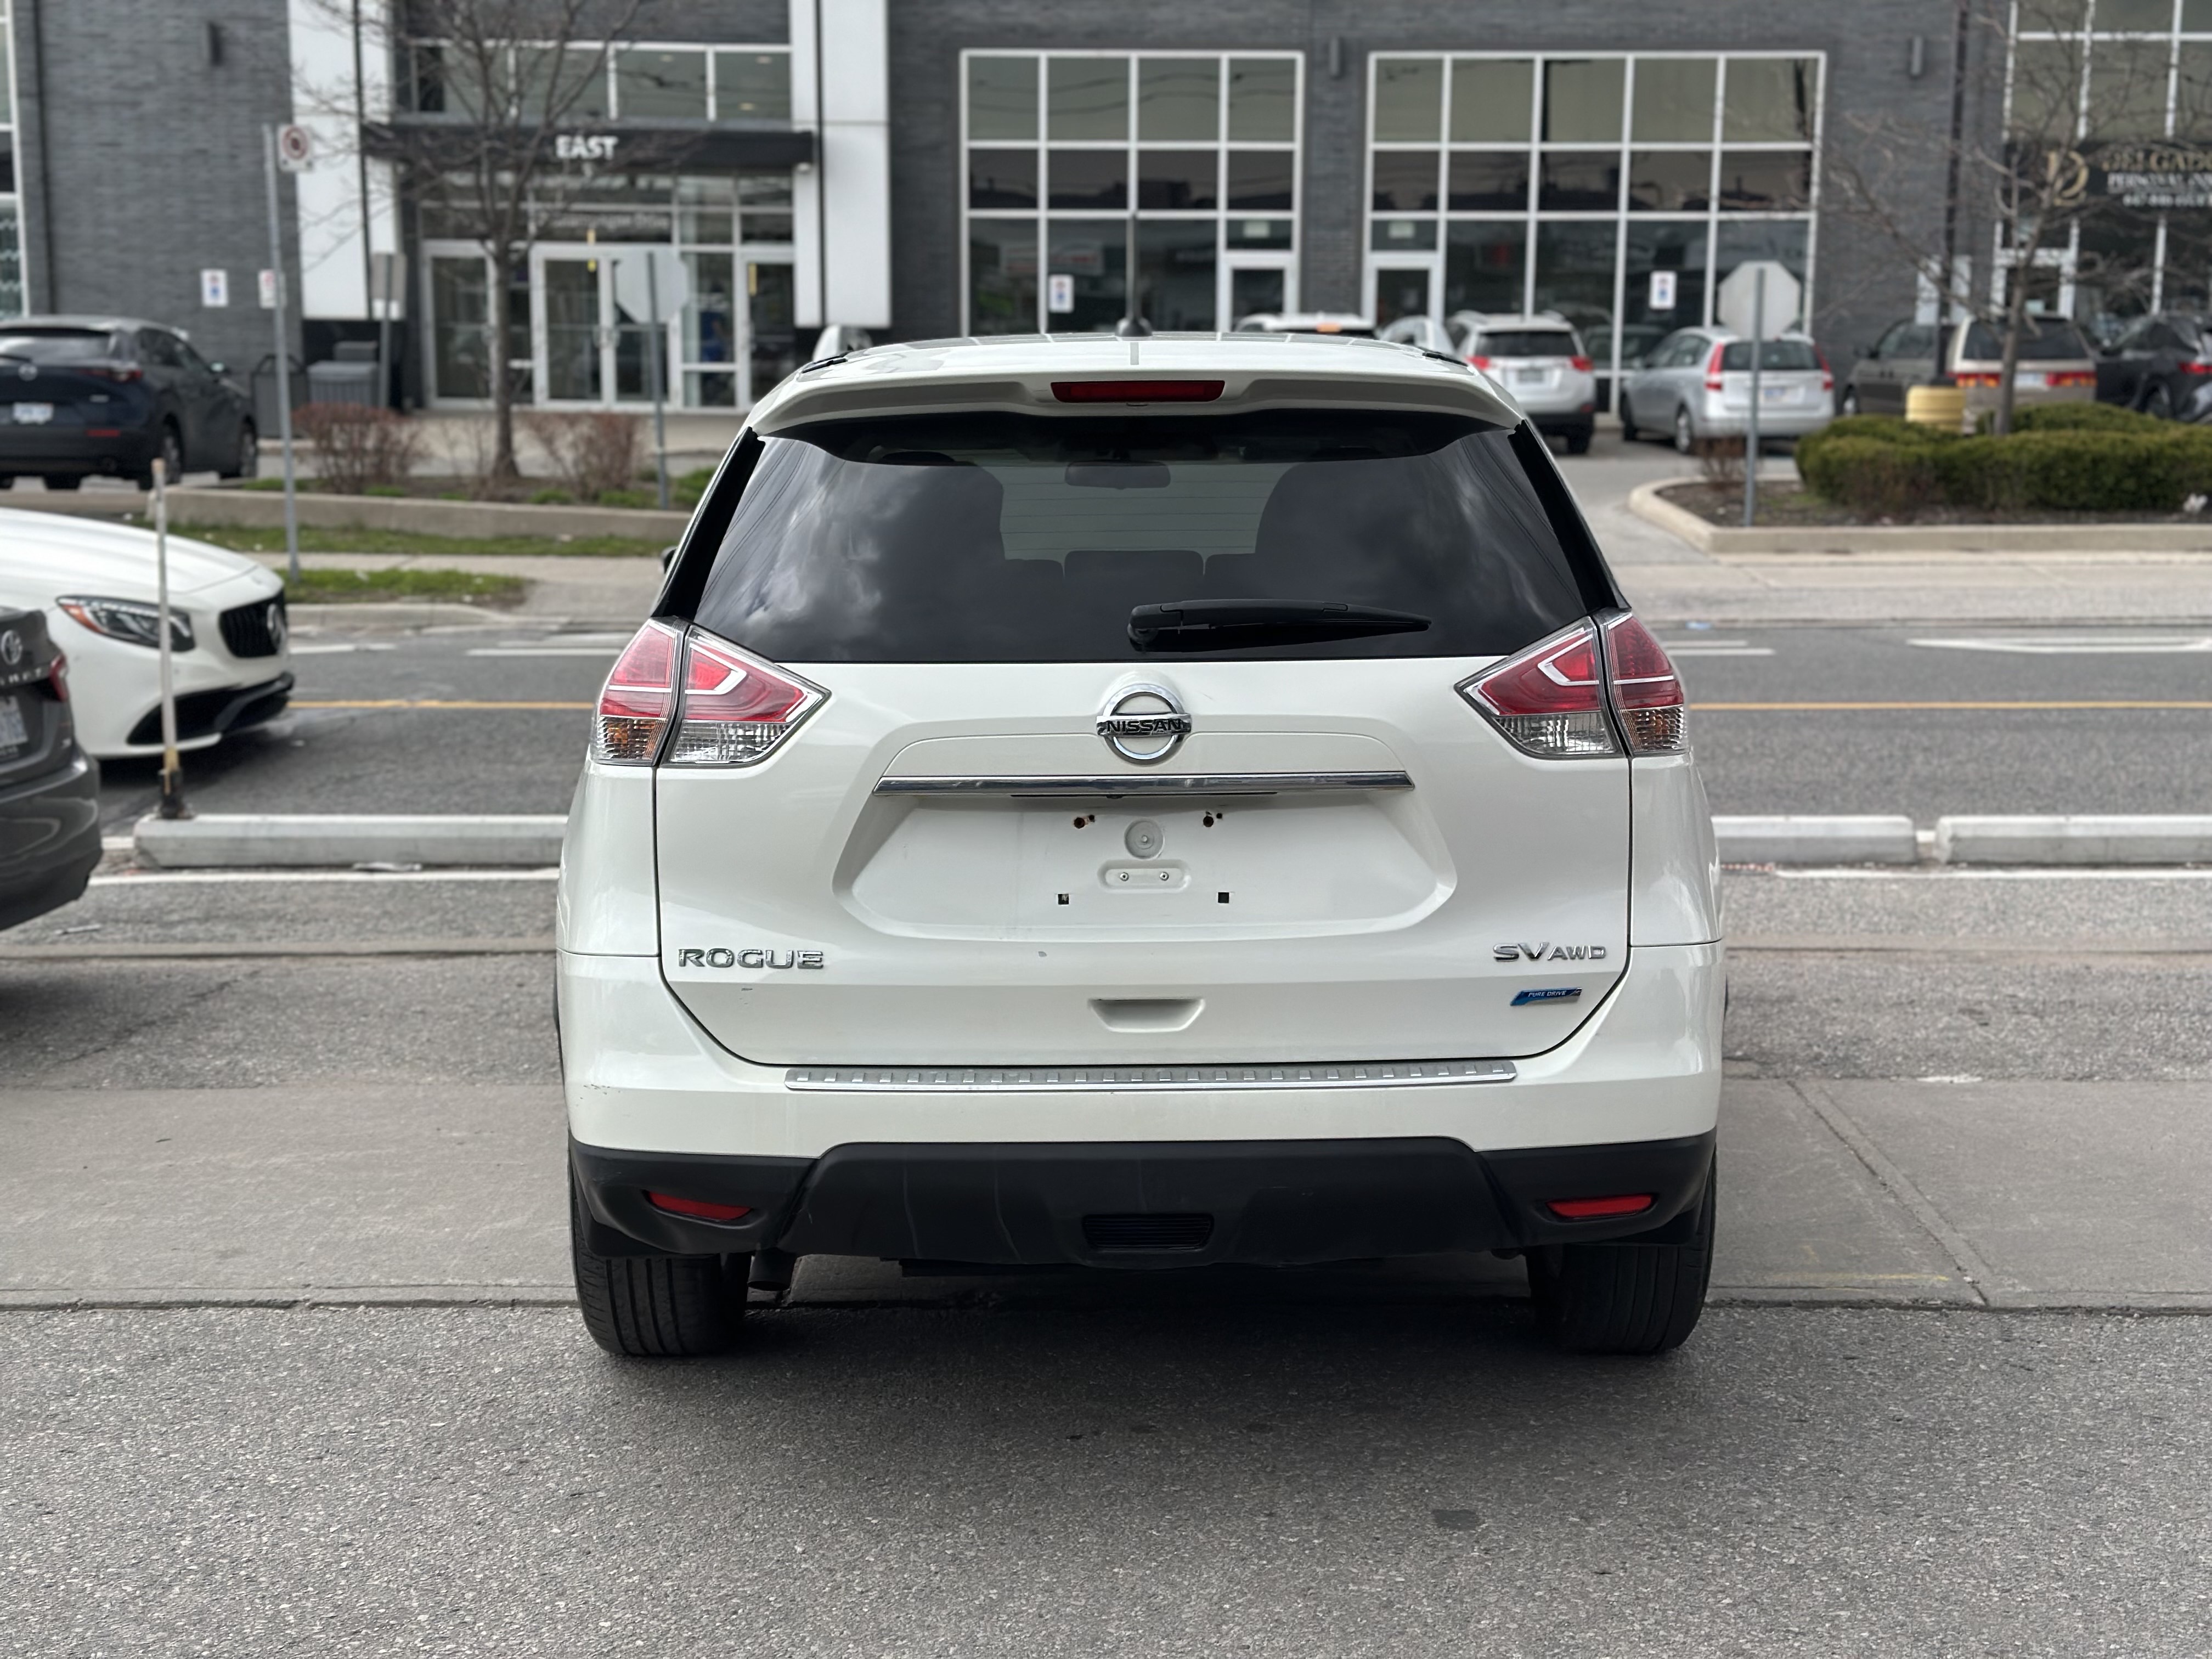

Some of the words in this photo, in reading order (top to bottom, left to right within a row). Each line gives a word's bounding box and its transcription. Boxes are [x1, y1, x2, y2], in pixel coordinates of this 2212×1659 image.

[556, 134, 619, 161] EAST
[1105, 718, 1182, 734] NISSAN
[678, 948, 823, 969] ROGUE
[1493, 941, 1549, 962] SV
[1547, 945, 1606, 961] AWD
